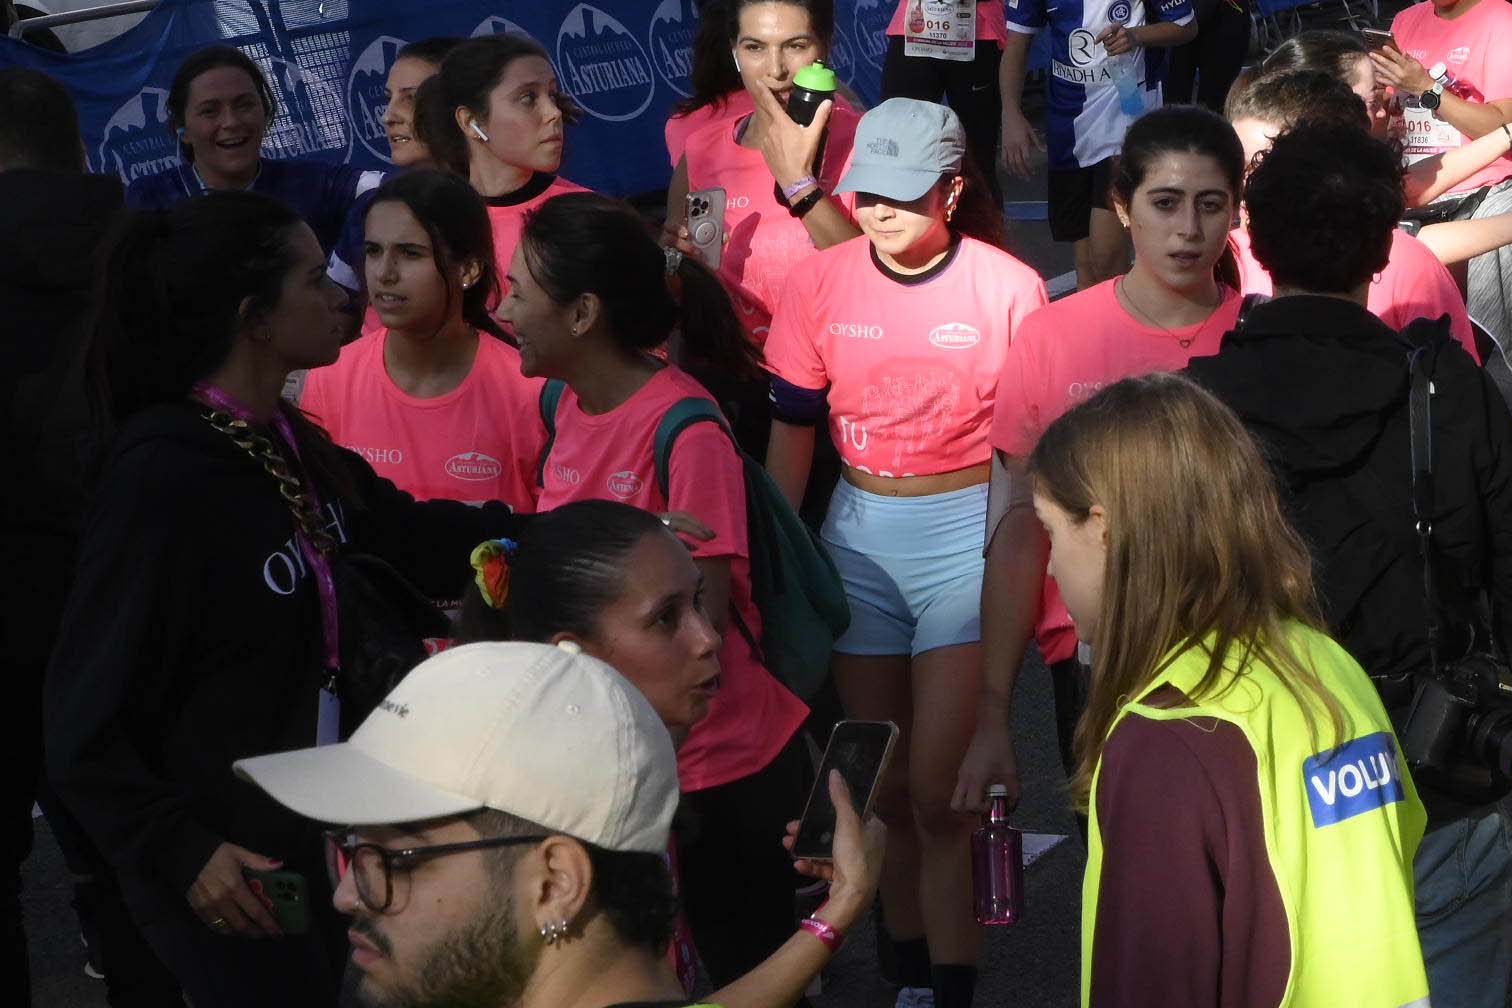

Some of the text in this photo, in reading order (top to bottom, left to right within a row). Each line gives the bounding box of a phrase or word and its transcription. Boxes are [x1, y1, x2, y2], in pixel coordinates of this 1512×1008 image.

[926, 20, 949, 30] 016
[565, 51, 651, 96] ASTURIANA
[1053, 61, 1094, 82] RIYADH
[1408, 120, 1431, 133] 016
[830, 322, 884, 340] OYSHO
[839, 416, 868, 450] TU
